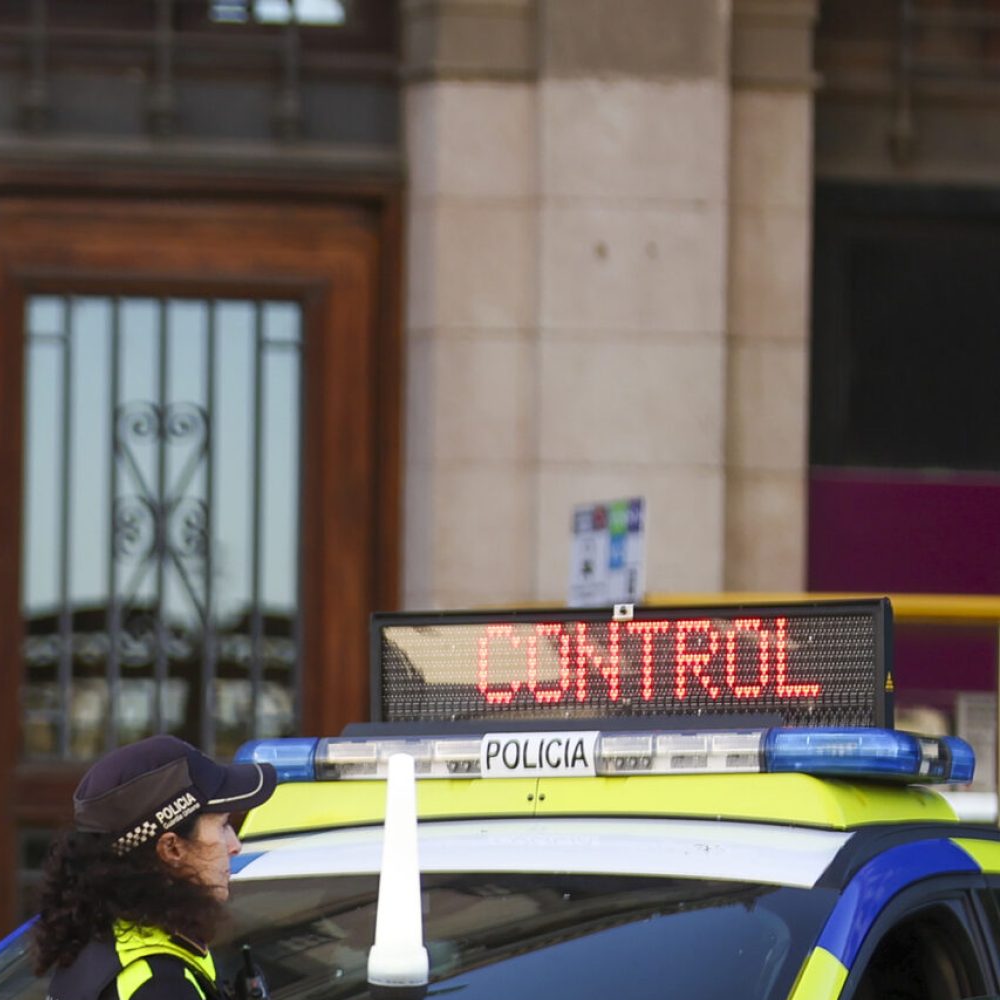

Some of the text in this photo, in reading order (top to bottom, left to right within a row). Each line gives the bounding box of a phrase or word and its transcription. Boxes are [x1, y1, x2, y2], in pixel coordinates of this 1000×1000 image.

[478, 617, 821, 704] CONTROL
[486, 738, 589, 771] POLICIA
[156, 792, 197, 825] POLICIA
